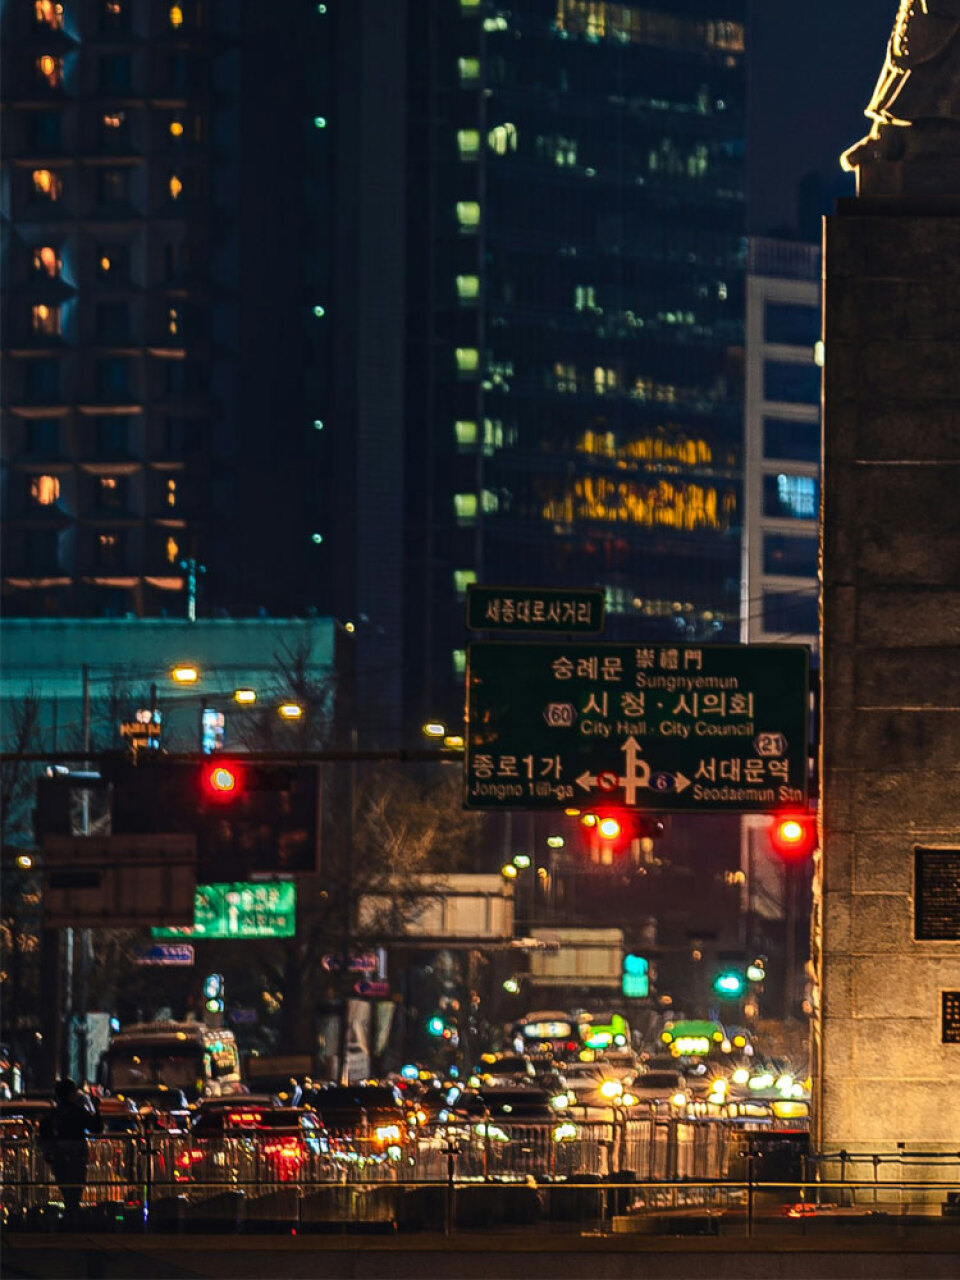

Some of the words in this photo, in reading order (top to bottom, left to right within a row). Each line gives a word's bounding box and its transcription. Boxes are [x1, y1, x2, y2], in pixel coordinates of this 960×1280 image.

[485, 598, 592, 625] 세종대로사거리
[552, 656, 623, 681] 숭례문
[635, 648, 703, 670] 崇禮門
[635, 672, 739, 692] Sungnyemun
[580, 720, 611, 737] City
[616, 719, 646, 735] Hall
[659, 721, 690, 738] City
[695, 721, 755, 736] Council
[472, 754, 563, 779] 종로1가
[694, 757, 789, 783] 서대문역
[471, 781, 523, 799] Jongno
[693, 784, 774, 802] Seodaemun
[778, 786, 803, 802] Stn
